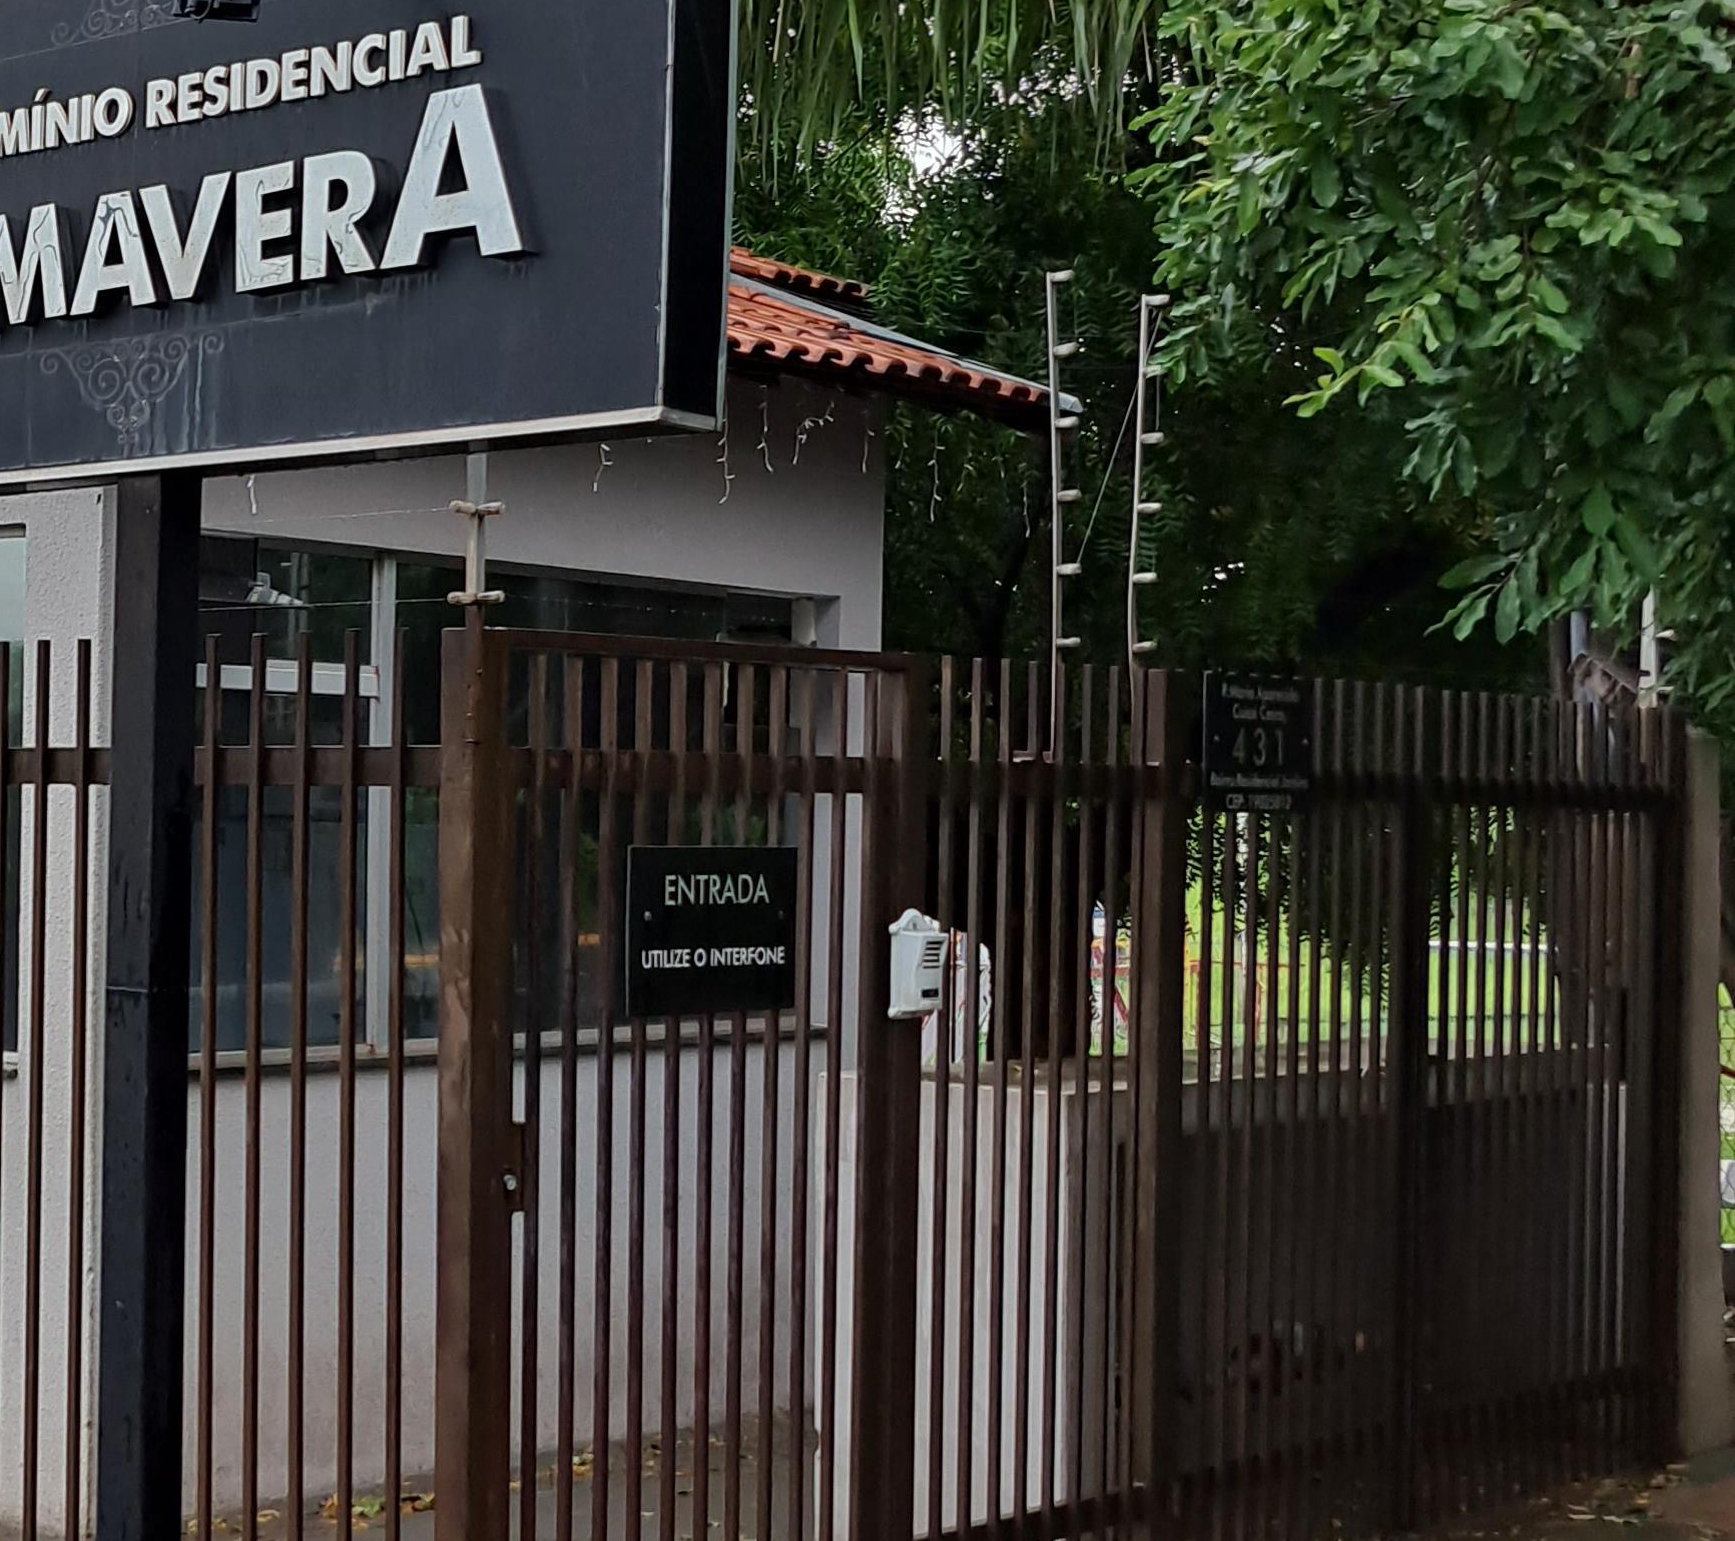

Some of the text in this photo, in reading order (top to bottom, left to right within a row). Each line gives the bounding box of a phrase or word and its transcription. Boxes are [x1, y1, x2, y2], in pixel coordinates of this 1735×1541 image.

[145, 13, 483, 129] RESIDENCIAL
[1232, 727, 1284, 767] 431
[664, 873, 770, 906] ENTRADA
[641, 945, 786, 970] UTILIZE O INTERFONE
